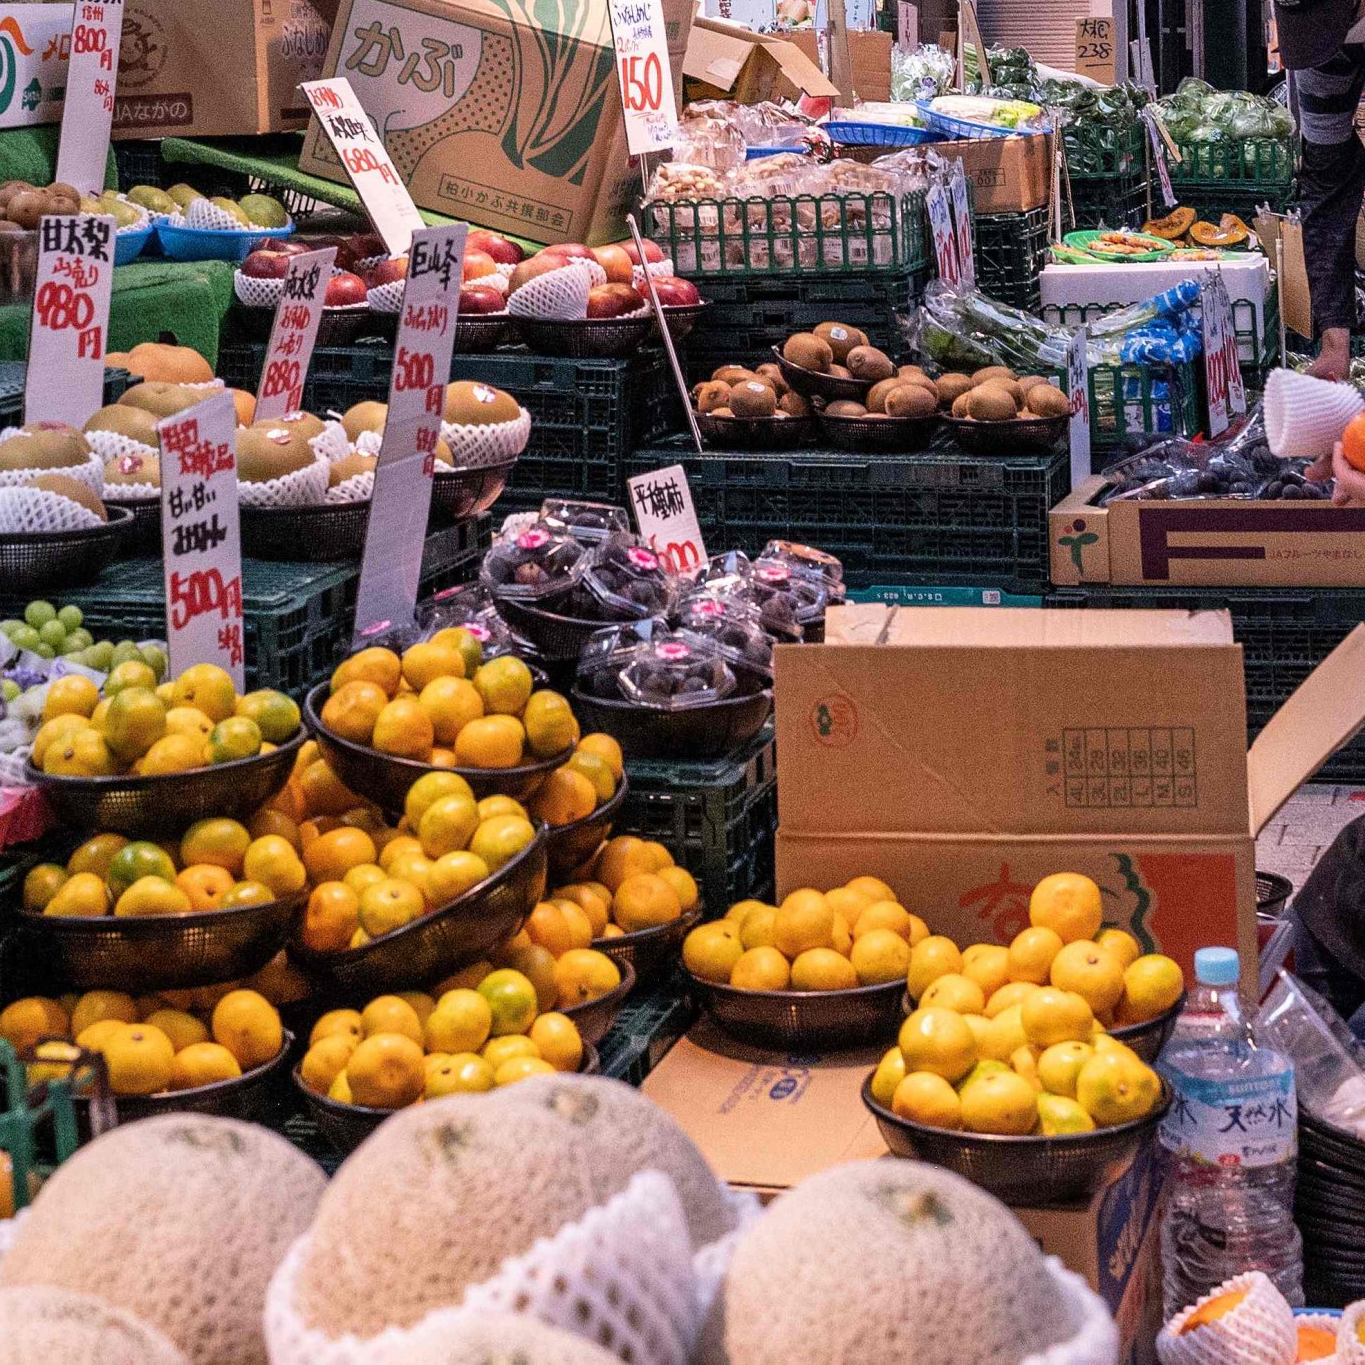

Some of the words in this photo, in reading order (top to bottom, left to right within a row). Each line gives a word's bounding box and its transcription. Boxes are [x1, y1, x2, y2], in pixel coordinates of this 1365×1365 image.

[82, 6, 104, 22] 信州
[74, 25, 113, 71] 800円
[345, 21, 463, 98] かぶ
[1078, 42, 1112, 59] 238
[622, 52, 663, 111] 150
[343, 147, 398, 186] 680円
[445, 181, 566, 228] 柏小かぶ共撰部会
[52, 256, 99, 288] 山売り
[411, 239, 458, 292] 巨峰
[37, 281, 102, 360] 980円
[262, 358, 302, 415] 880円
[395, 347, 444, 417] 500円
[170, 566, 243, 632] 500円
[1155, 748, 1169, 770] 40
[1218, 1098, 1293, 1134] 天然水
